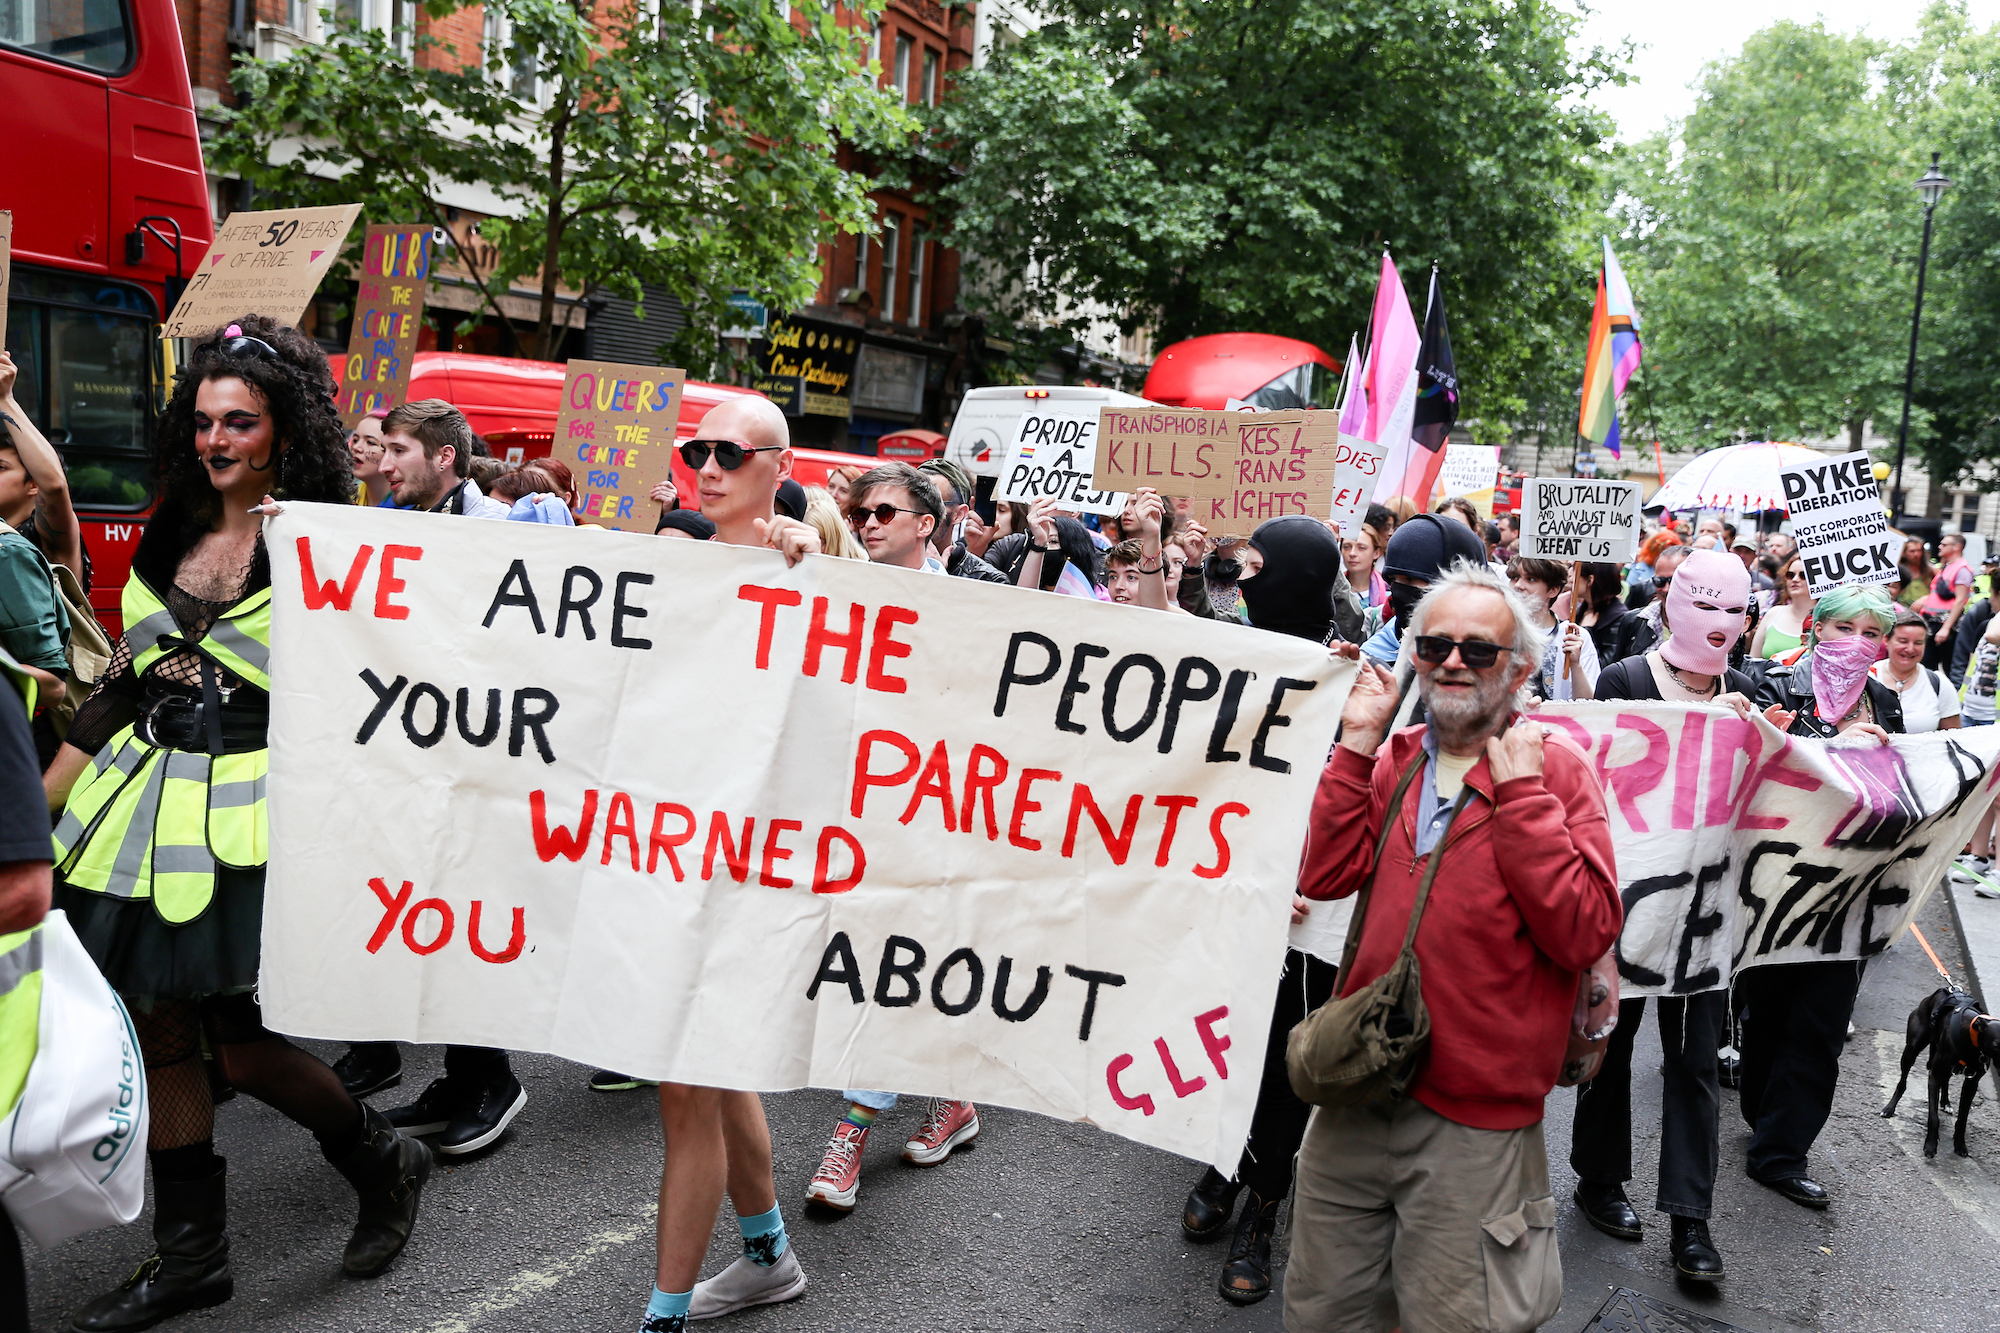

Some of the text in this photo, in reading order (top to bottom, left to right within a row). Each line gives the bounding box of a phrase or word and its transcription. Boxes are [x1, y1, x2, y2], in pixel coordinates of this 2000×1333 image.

[218, 219, 344, 247] AFTER 50 YEARS
[231, 253, 252, 268] OF
[366, 232, 432, 280] QUEERS
[191, 274, 288, 291] 71 JURISDICTIONS STILL
[204, 290, 248, 300] CRIMINALISE
[359, 283, 380, 301] FOR
[391, 286, 413, 305] THE
[175, 301, 193, 318] 11
[191, 306, 212, 317] STILL
[215, 305, 241, 315] IMPOSE
[242, 305, 258, 314] THE
[259, 305, 279, 314] DEATH
[165, 322, 183, 338] 15
[362, 309, 412, 338] CENTRE
[767, 319, 803, 355] Gold
[373, 339, 396, 359] FOR
[348, 353, 400, 383] QUEER
[770, 353, 850, 394] Coin Exchange
[338, 388, 396, 414] HISTORY
[570, 373, 675, 414] QUEERS
[568, 419, 651, 446] FOR THE
[1020, 416, 1096, 449] PRIDE
[1105, 413, 1229, 436] TRANSPHOBIA
[577, 443, 639, 468] CENTRE
[1239, 427, 1312, 460] KES 4
[1053, 449, 1073, 470] A
[1108, 439, 1222, 479] KILLS.
[1235, 458, 1306, 485] RANS
[1335, 445, 1382, 475] DIES
[588, 470, 620, 489] FOR
[1780, 457, 1874, 500] DYKE
[574, 493, 635, 519] UEER
[1538, 483, 1632, 510] BRUTALITY
[1788, 485, 1878, 515] LIBERATION
[1537, 509, 1633, 528] AND UNJUST LAWS
[1538, 519, 1602, 537] CANNOT
[1795, 511, 1884, 538] NOT CORPORATE
[105, 524, 132, 541] HV
[1799, 522, 1887, 550] ASSIMILATION
[1536, 538, 1611, 557] DEFEAT US
[1803, 542, 1896, 586] FUCK
[1690, 584, 1722, 599] brat
[296, 536, 1318, 775] WE ARE THE PEOPLE
[353, 667, 1251, 880] YOUR PARENTS
[529, 788, 866, 894] WARNED
[365, 877, 1127, 1042] YOU ABOUT
[93, 1039, 134, 1162] adidas
